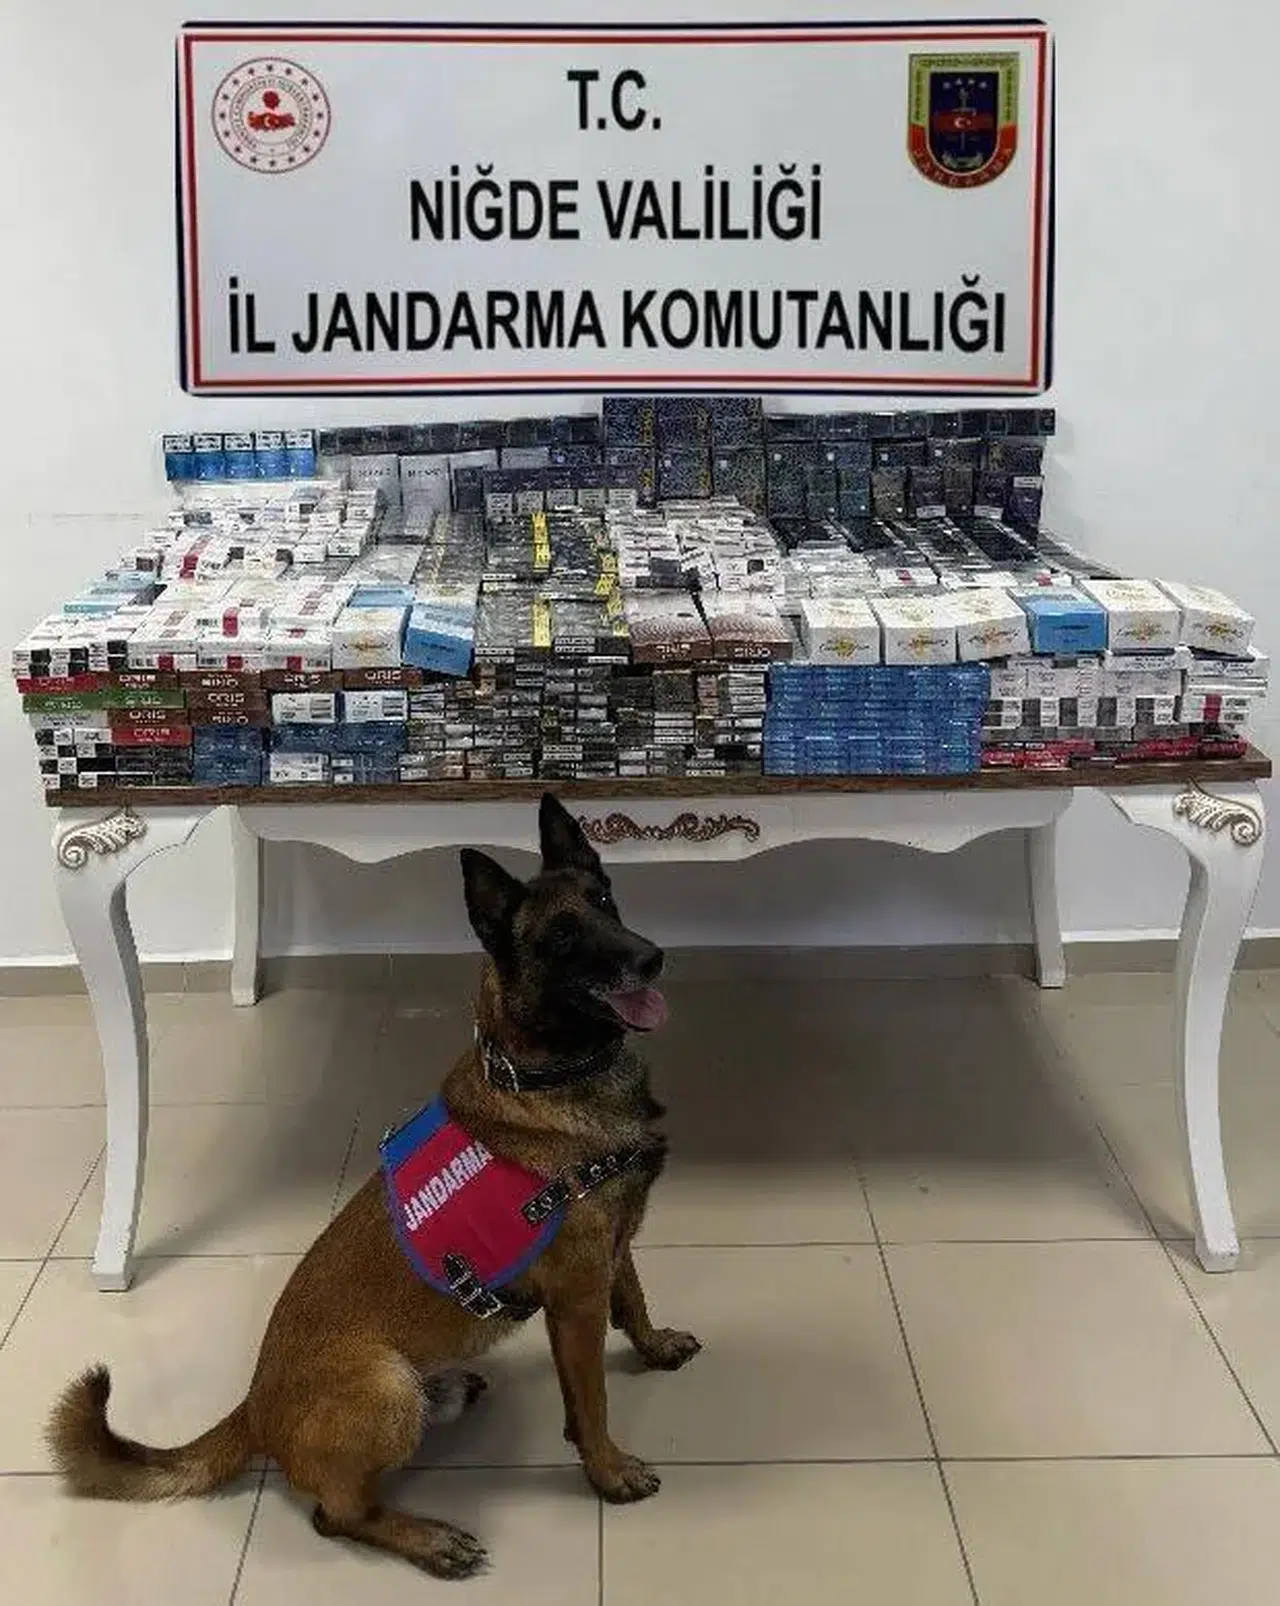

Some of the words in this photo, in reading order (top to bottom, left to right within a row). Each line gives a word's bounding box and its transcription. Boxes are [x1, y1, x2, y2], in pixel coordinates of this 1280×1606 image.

[568, 70, 660, 130] T.C.
[411, 165, 579, 241] NİĞDE
[597, 164, 820, 240] VALİLİĞİ
[230, 277, 275, 353] İL
[292, 290, 606, 353] JANDARMA
[624, 275, 1004, 353] KOMUTANLIĞI
[207, 692, 245, 703] ORIS
[364, 670, 401, 680] ORIS
[128, 709, 167, 720] ORIS
[403, 1141, 494, 1232] JANDARMA
